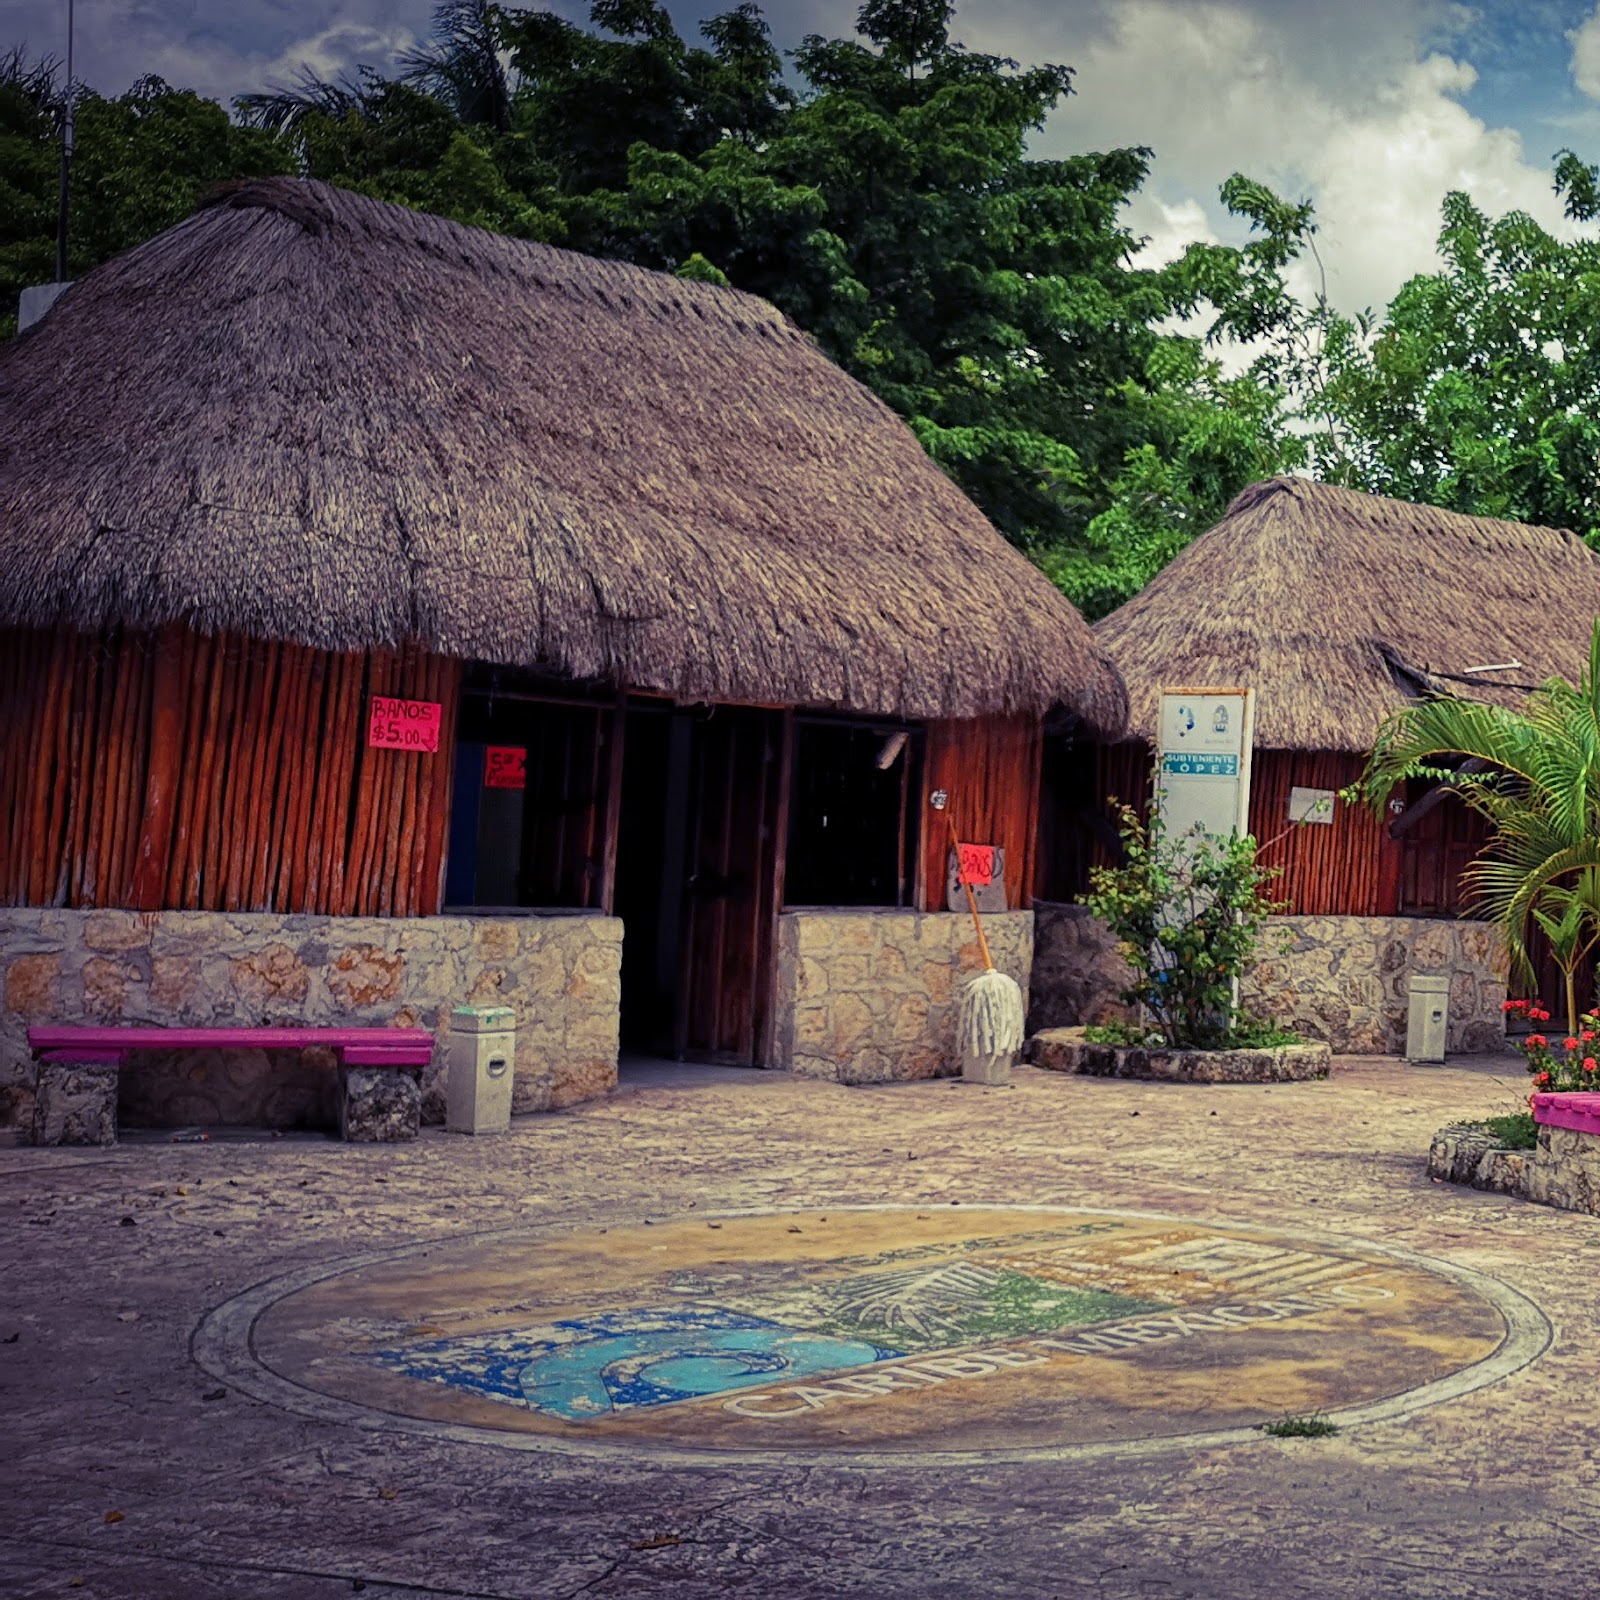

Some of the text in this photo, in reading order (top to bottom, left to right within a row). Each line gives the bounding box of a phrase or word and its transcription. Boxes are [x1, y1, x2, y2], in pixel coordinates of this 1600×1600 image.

[1166, 754, 1235, 764] SUBTENIENTE
[722, 1283, 1396, 1418] CARIBE MEXICANO
